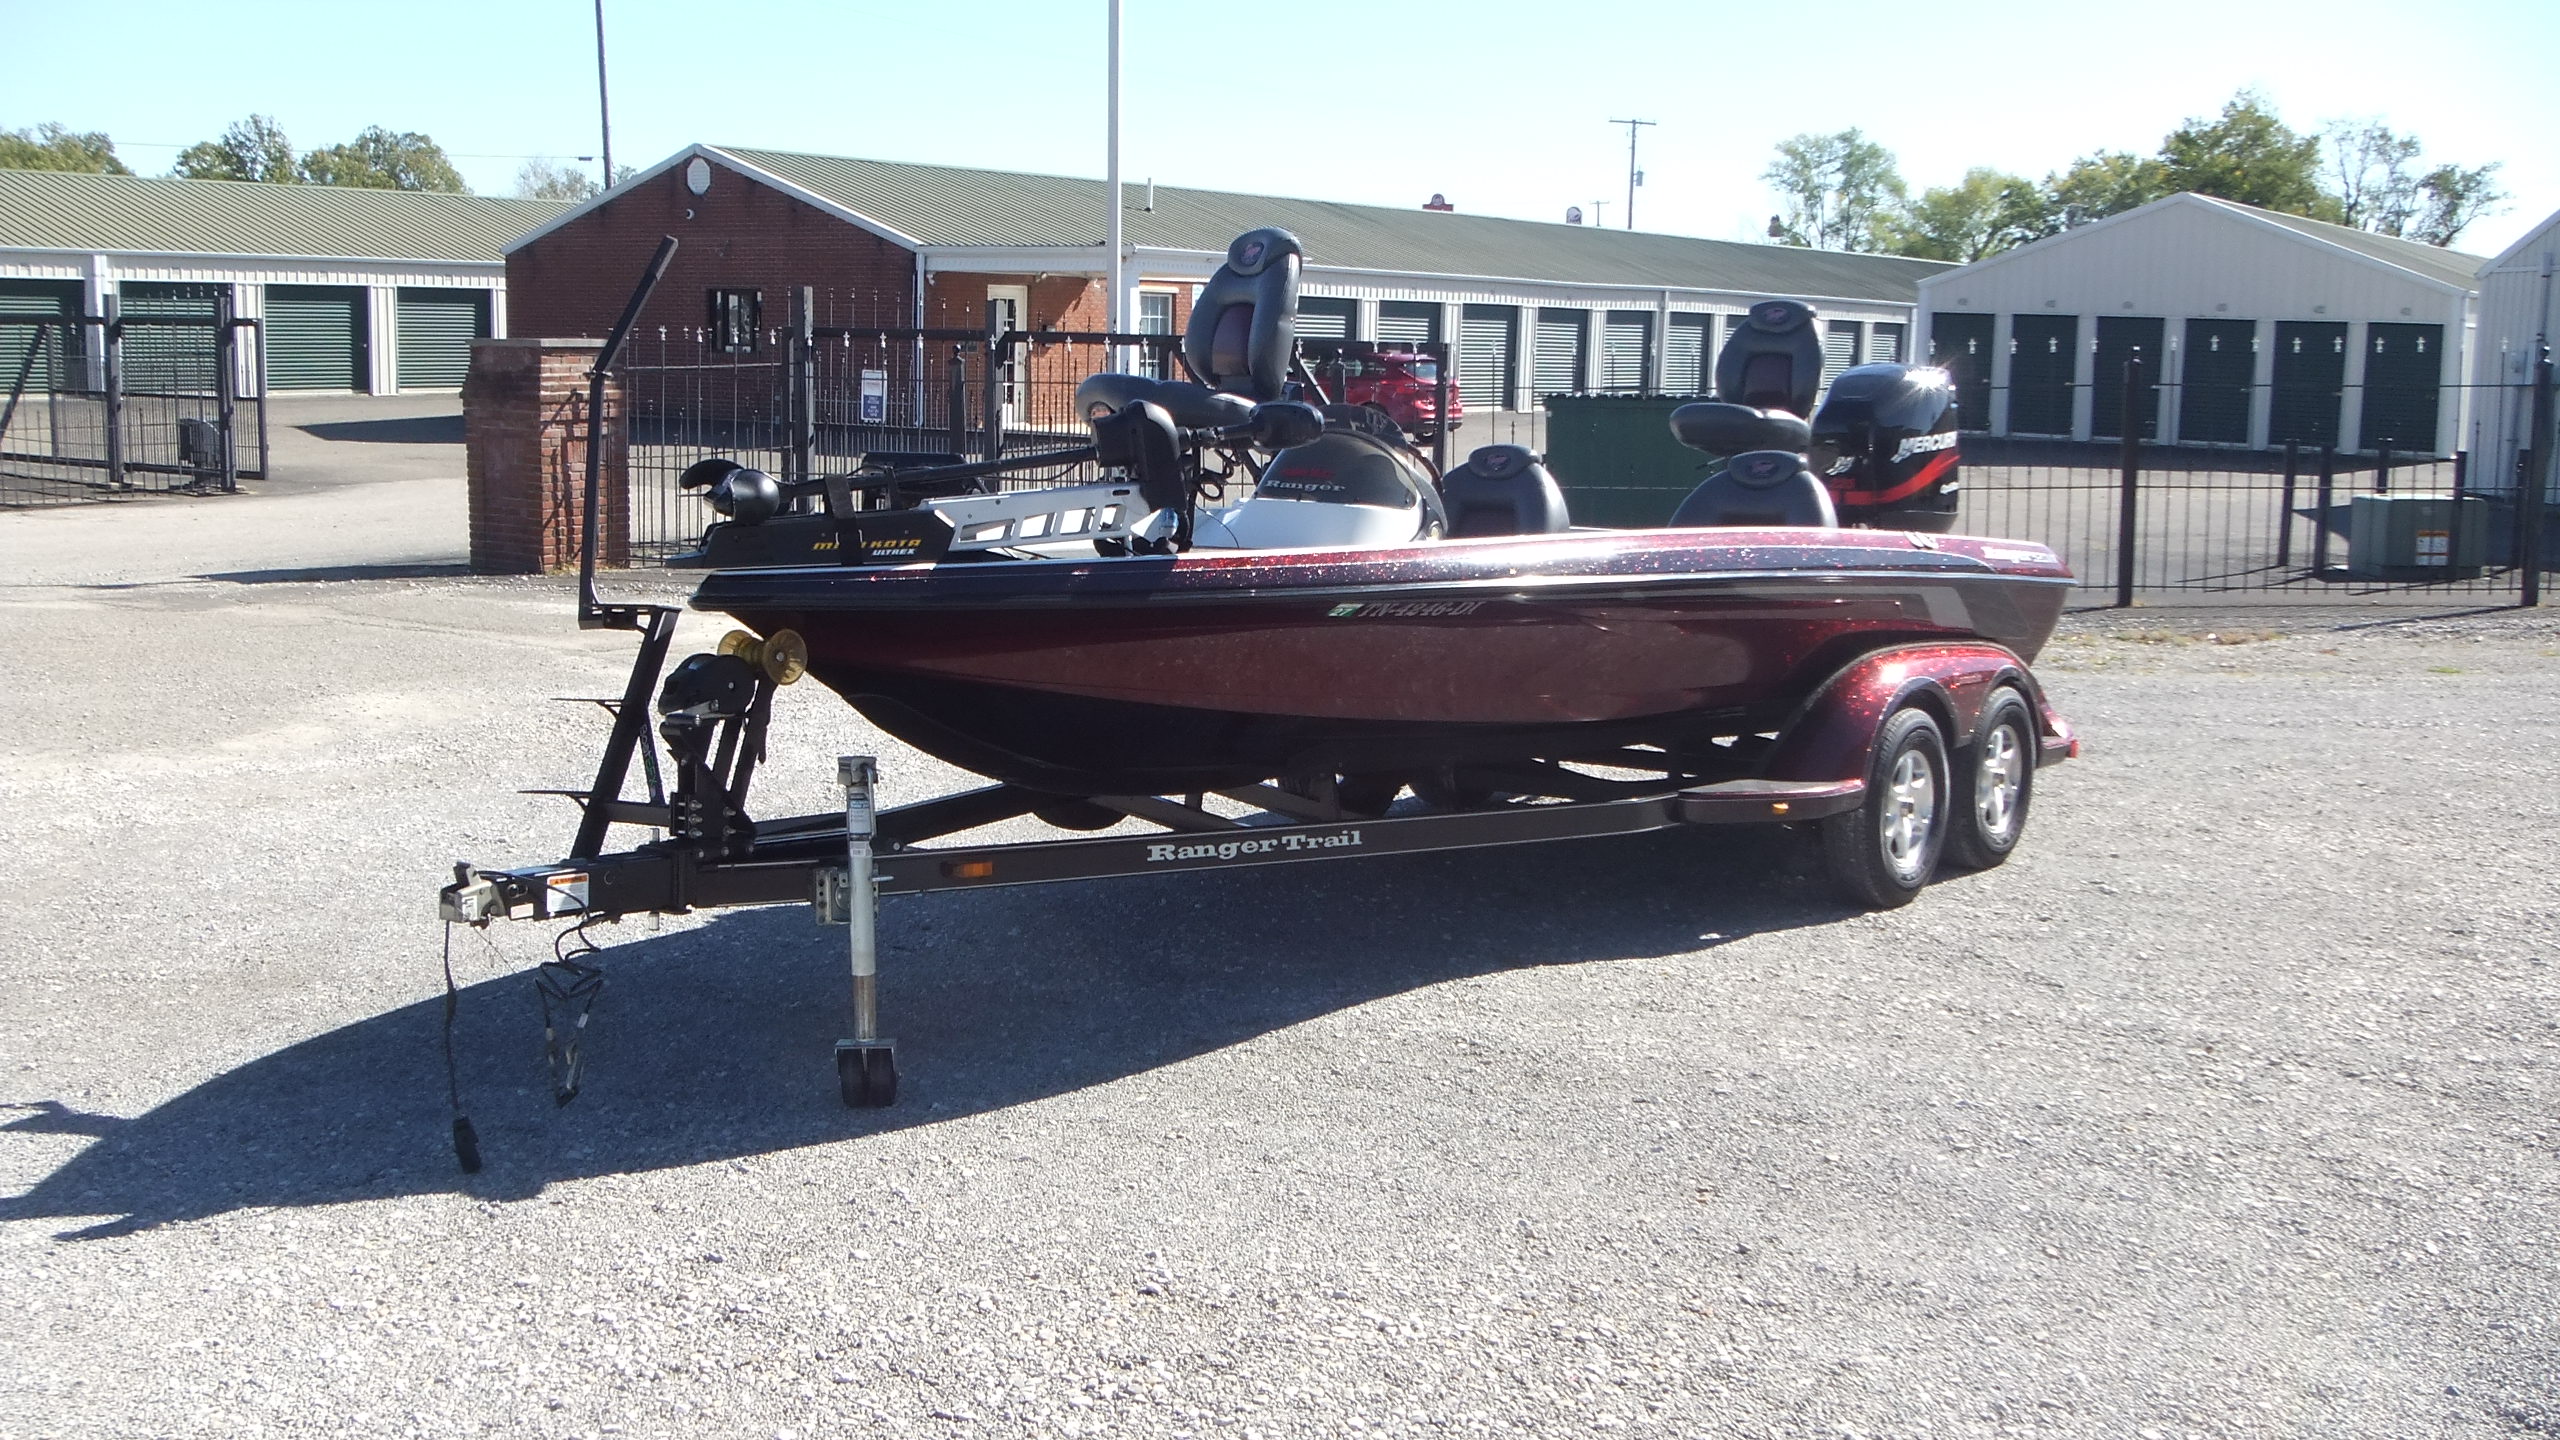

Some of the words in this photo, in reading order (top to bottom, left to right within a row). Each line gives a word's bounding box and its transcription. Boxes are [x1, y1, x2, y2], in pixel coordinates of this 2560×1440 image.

[1265, 479, 1347, 492] Ranger
[1146, 837, 1278, 861] Ranger
[1281, 830, 1363, 851] Trail
